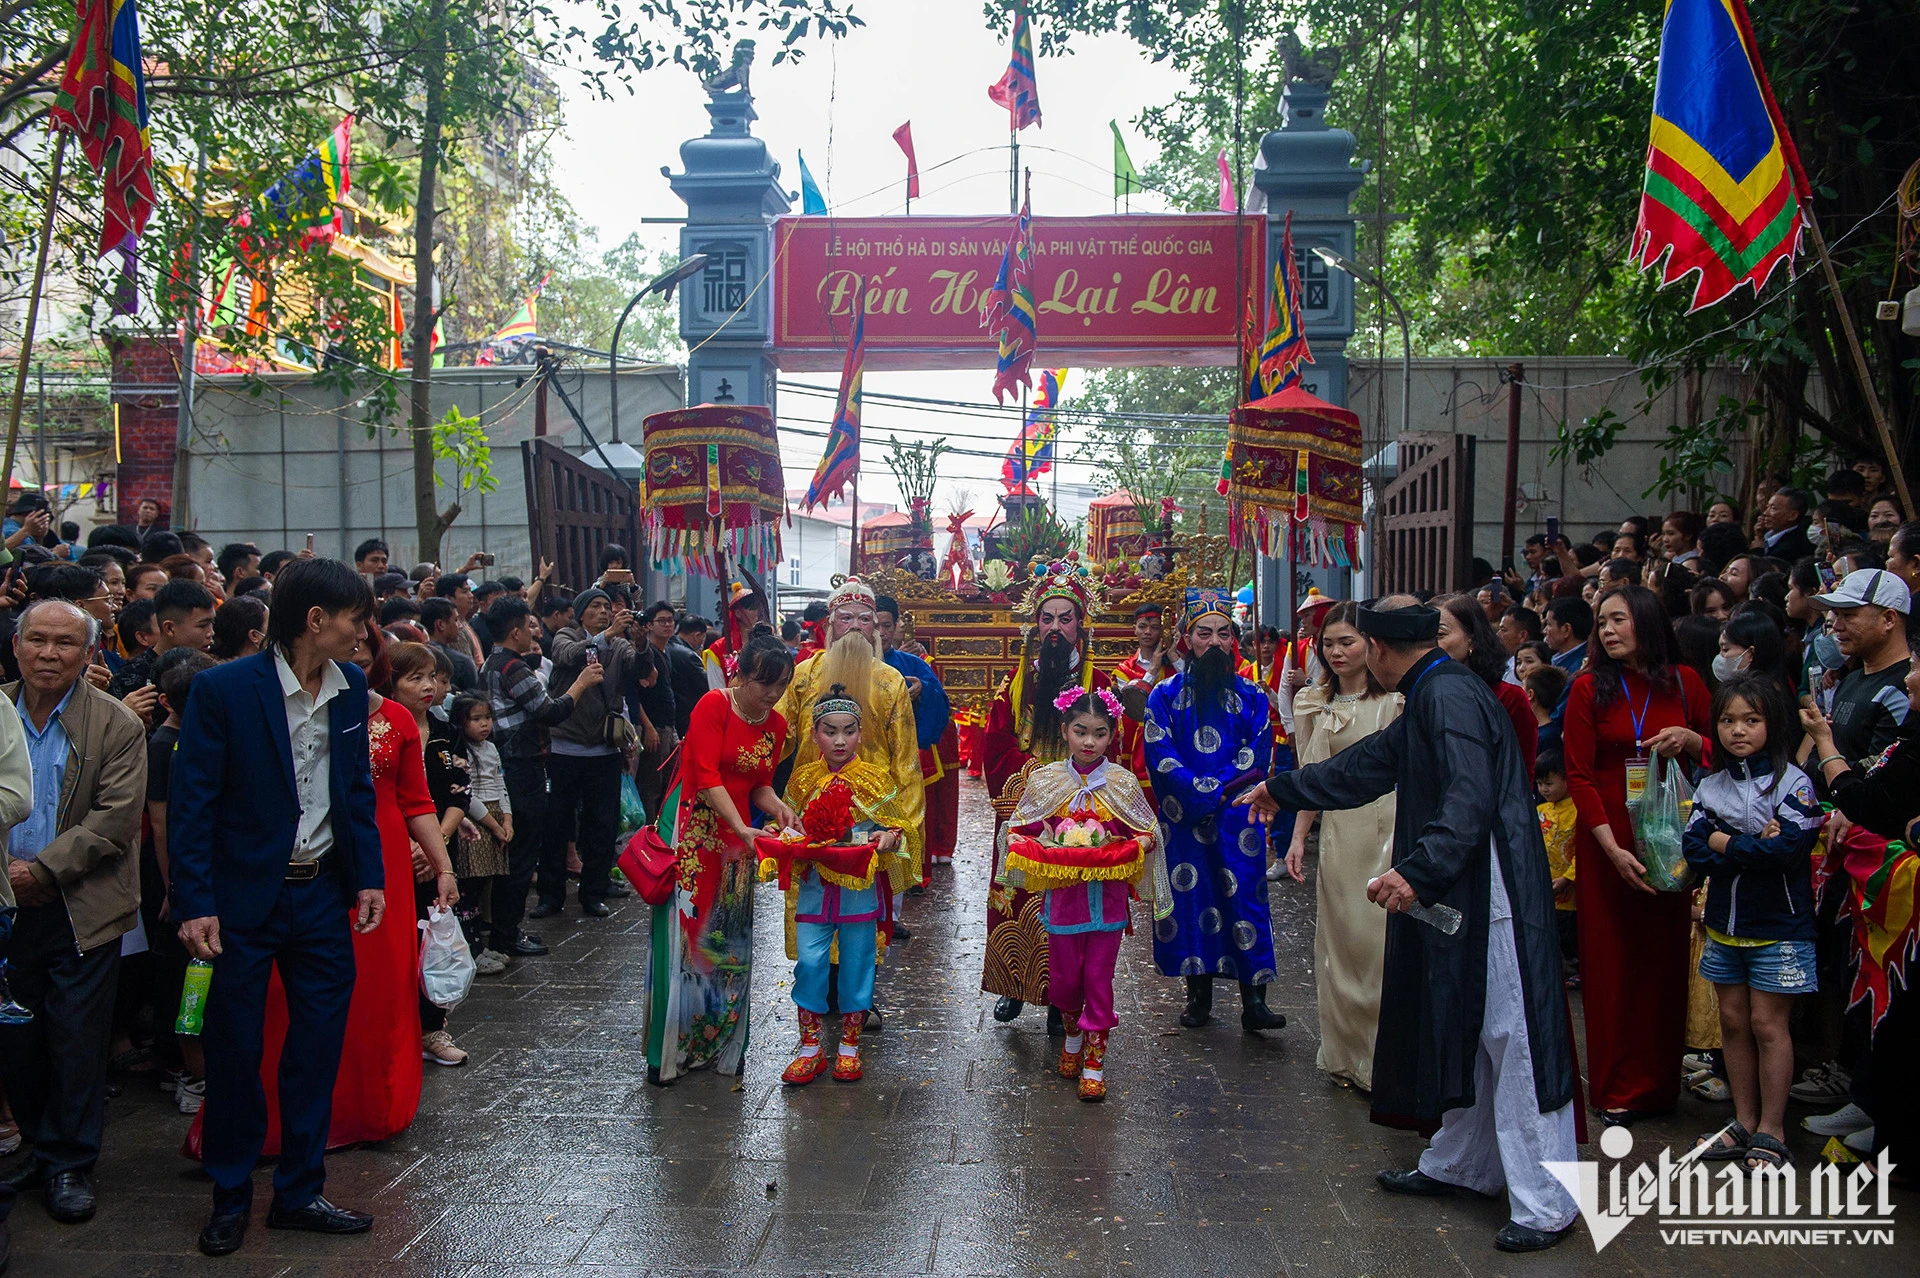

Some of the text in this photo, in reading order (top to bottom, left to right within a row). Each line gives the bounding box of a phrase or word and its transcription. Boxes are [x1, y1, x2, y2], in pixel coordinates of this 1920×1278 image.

[825, 235, 842, 257] LỄ
[846, 237, 871, 260] HỘI
[874, 233, 904, 257] THỔ
[907, 236, 928, 257] HÀ
[931, 241, 945, 256] DI
[948, 236, 978, 256] SẢN
[1050, 240, 1074, 256] PHI
[1077, 237, 1107, 259] VẬT
[1109, 233, 1138, 256] THỂ
[1141, 234, 1184, 256] QUỐC
[1188, 240, 1214, 255] GIA
[816, 266, 912, 316] Đến
[1037, 268, 1122, 327] Lại
[1130, 268, 1221, 315] Lên
